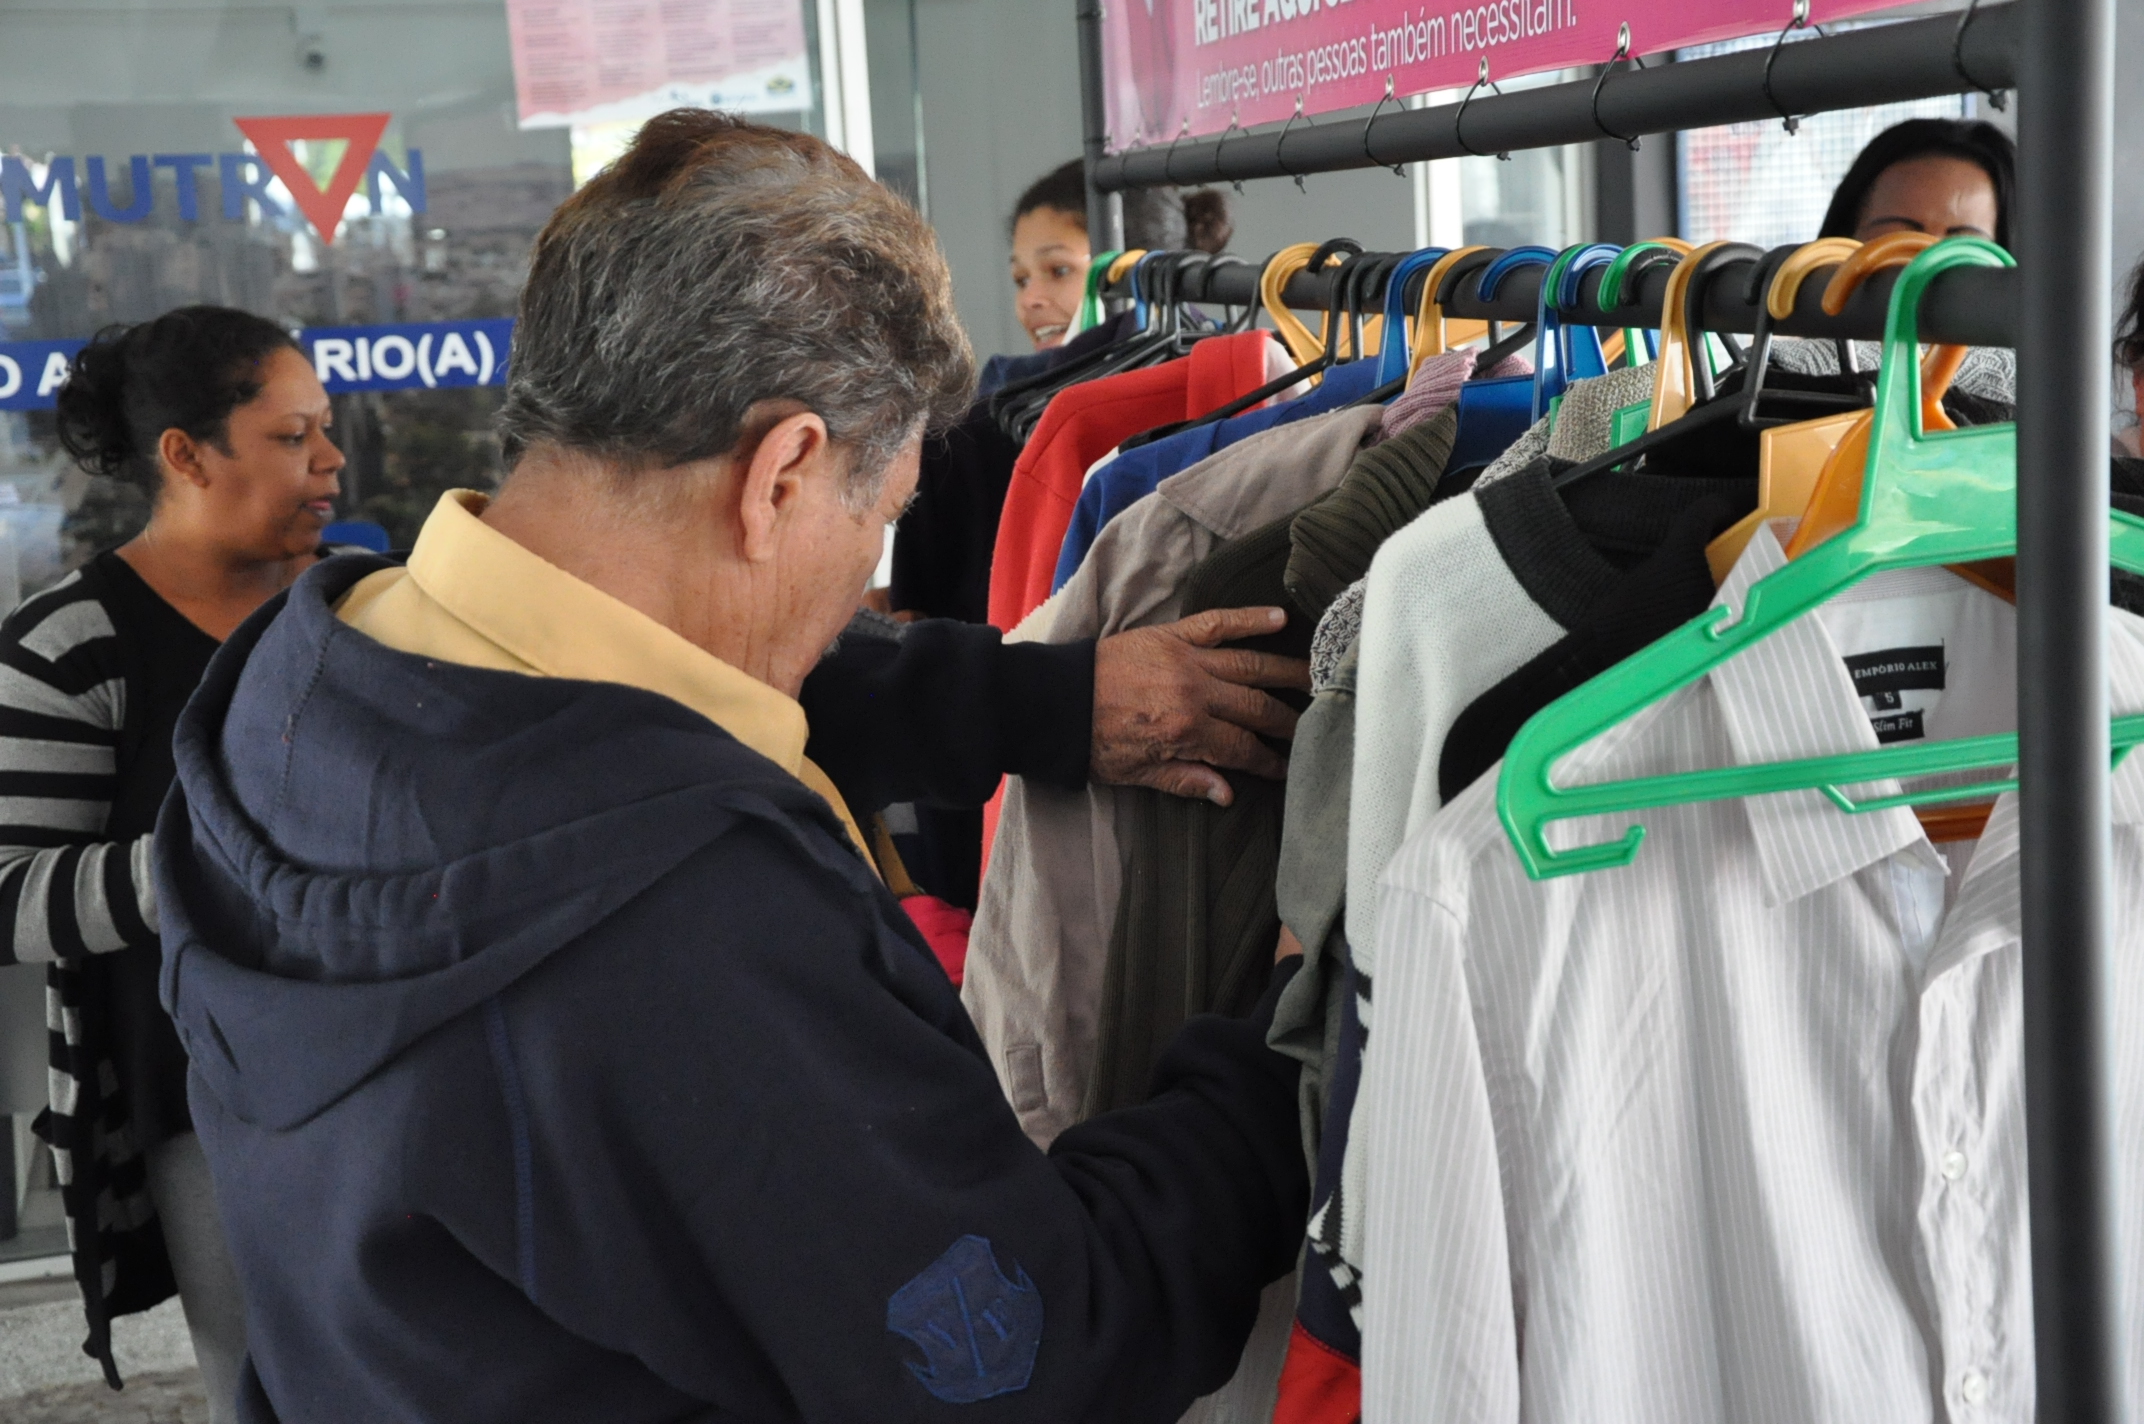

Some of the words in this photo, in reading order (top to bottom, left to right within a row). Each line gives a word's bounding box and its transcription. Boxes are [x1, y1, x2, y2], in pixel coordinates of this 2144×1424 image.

[1197, 60, 1260, 108] Lembre-se,
[1262, 48, 1304, 94] outras
[1307, 36, 1367, 95] pessoas
[1371, 6, 1446, 71] também
[1907, 661, 1937, 671] ALEX
[1873, 718, 1896, 732] Slim
[1898, 717, 1914, 730] Fit
